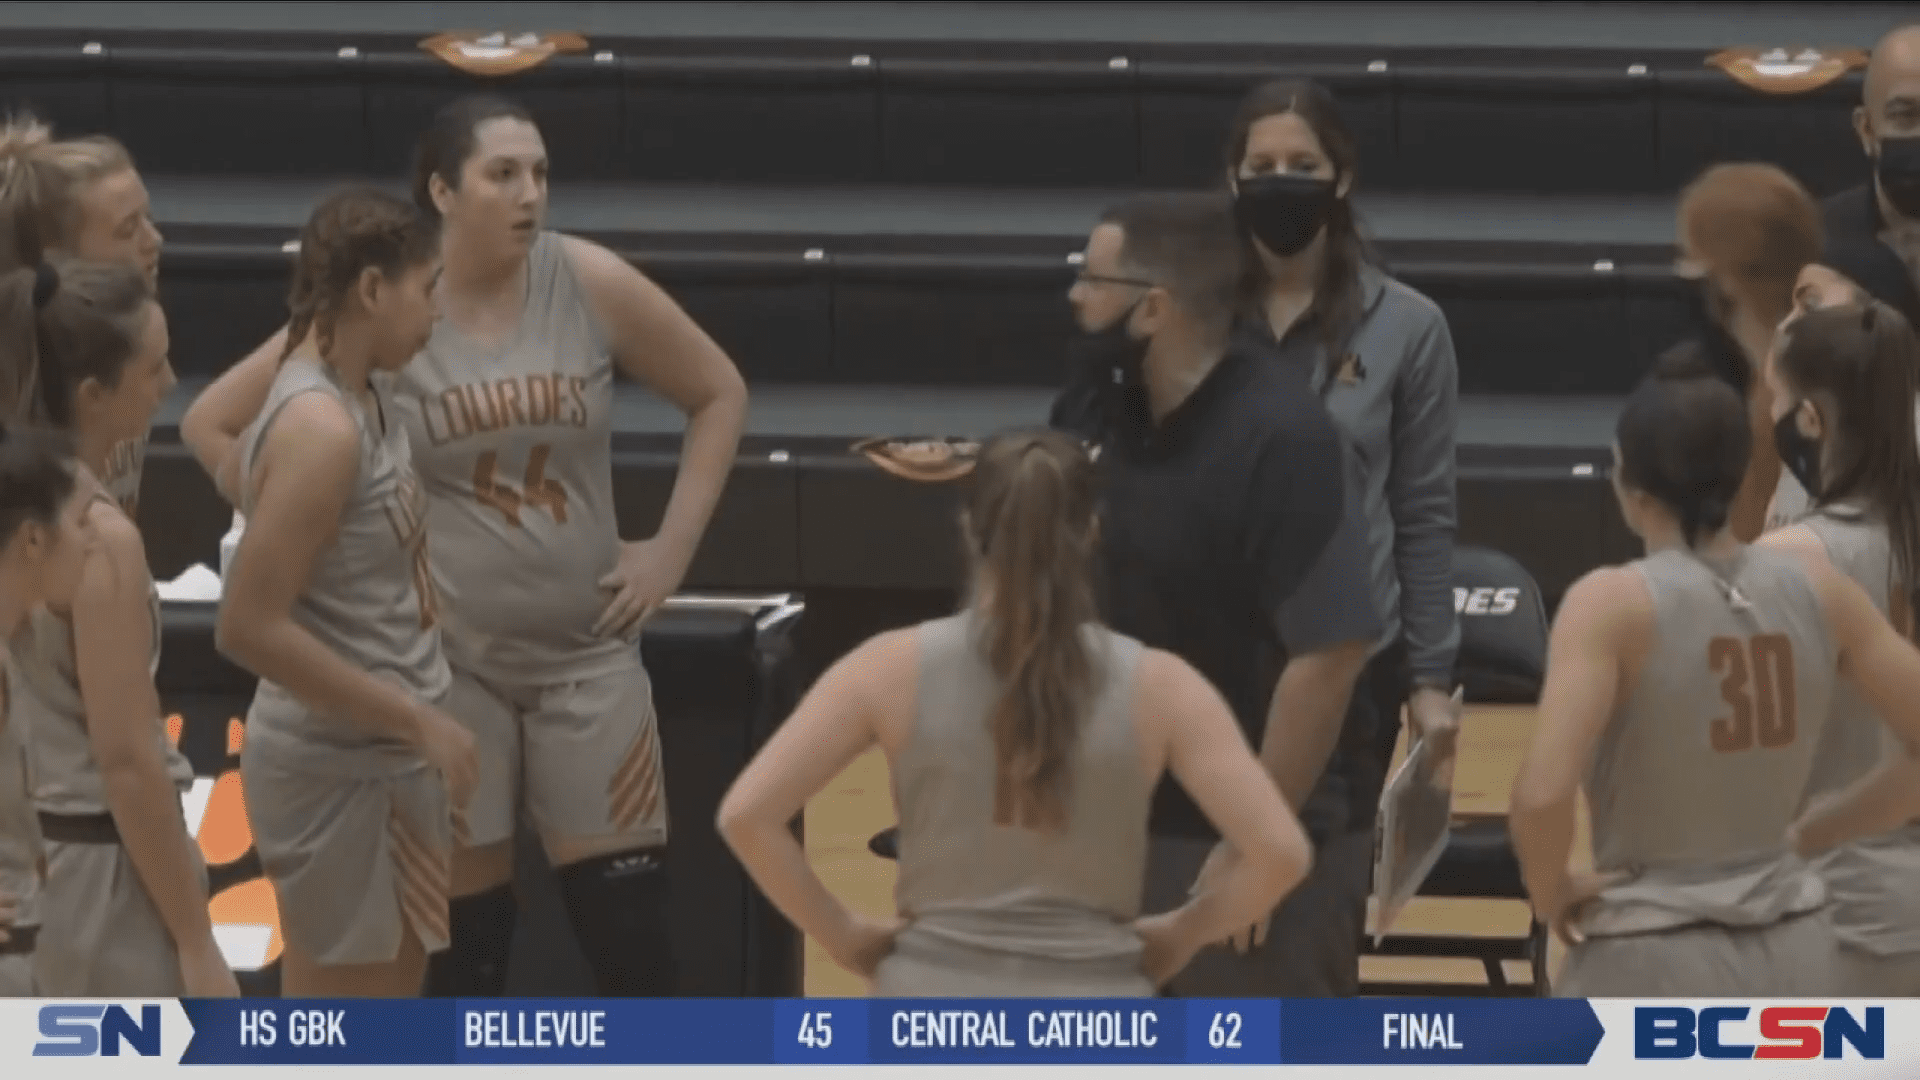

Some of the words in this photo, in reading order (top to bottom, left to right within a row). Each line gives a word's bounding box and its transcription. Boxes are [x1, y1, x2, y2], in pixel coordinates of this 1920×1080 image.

[419, 373, 588, 446] LOURDES
[472, 445, 568, 528] 44
[1709, 634, 1797, 753] 30
